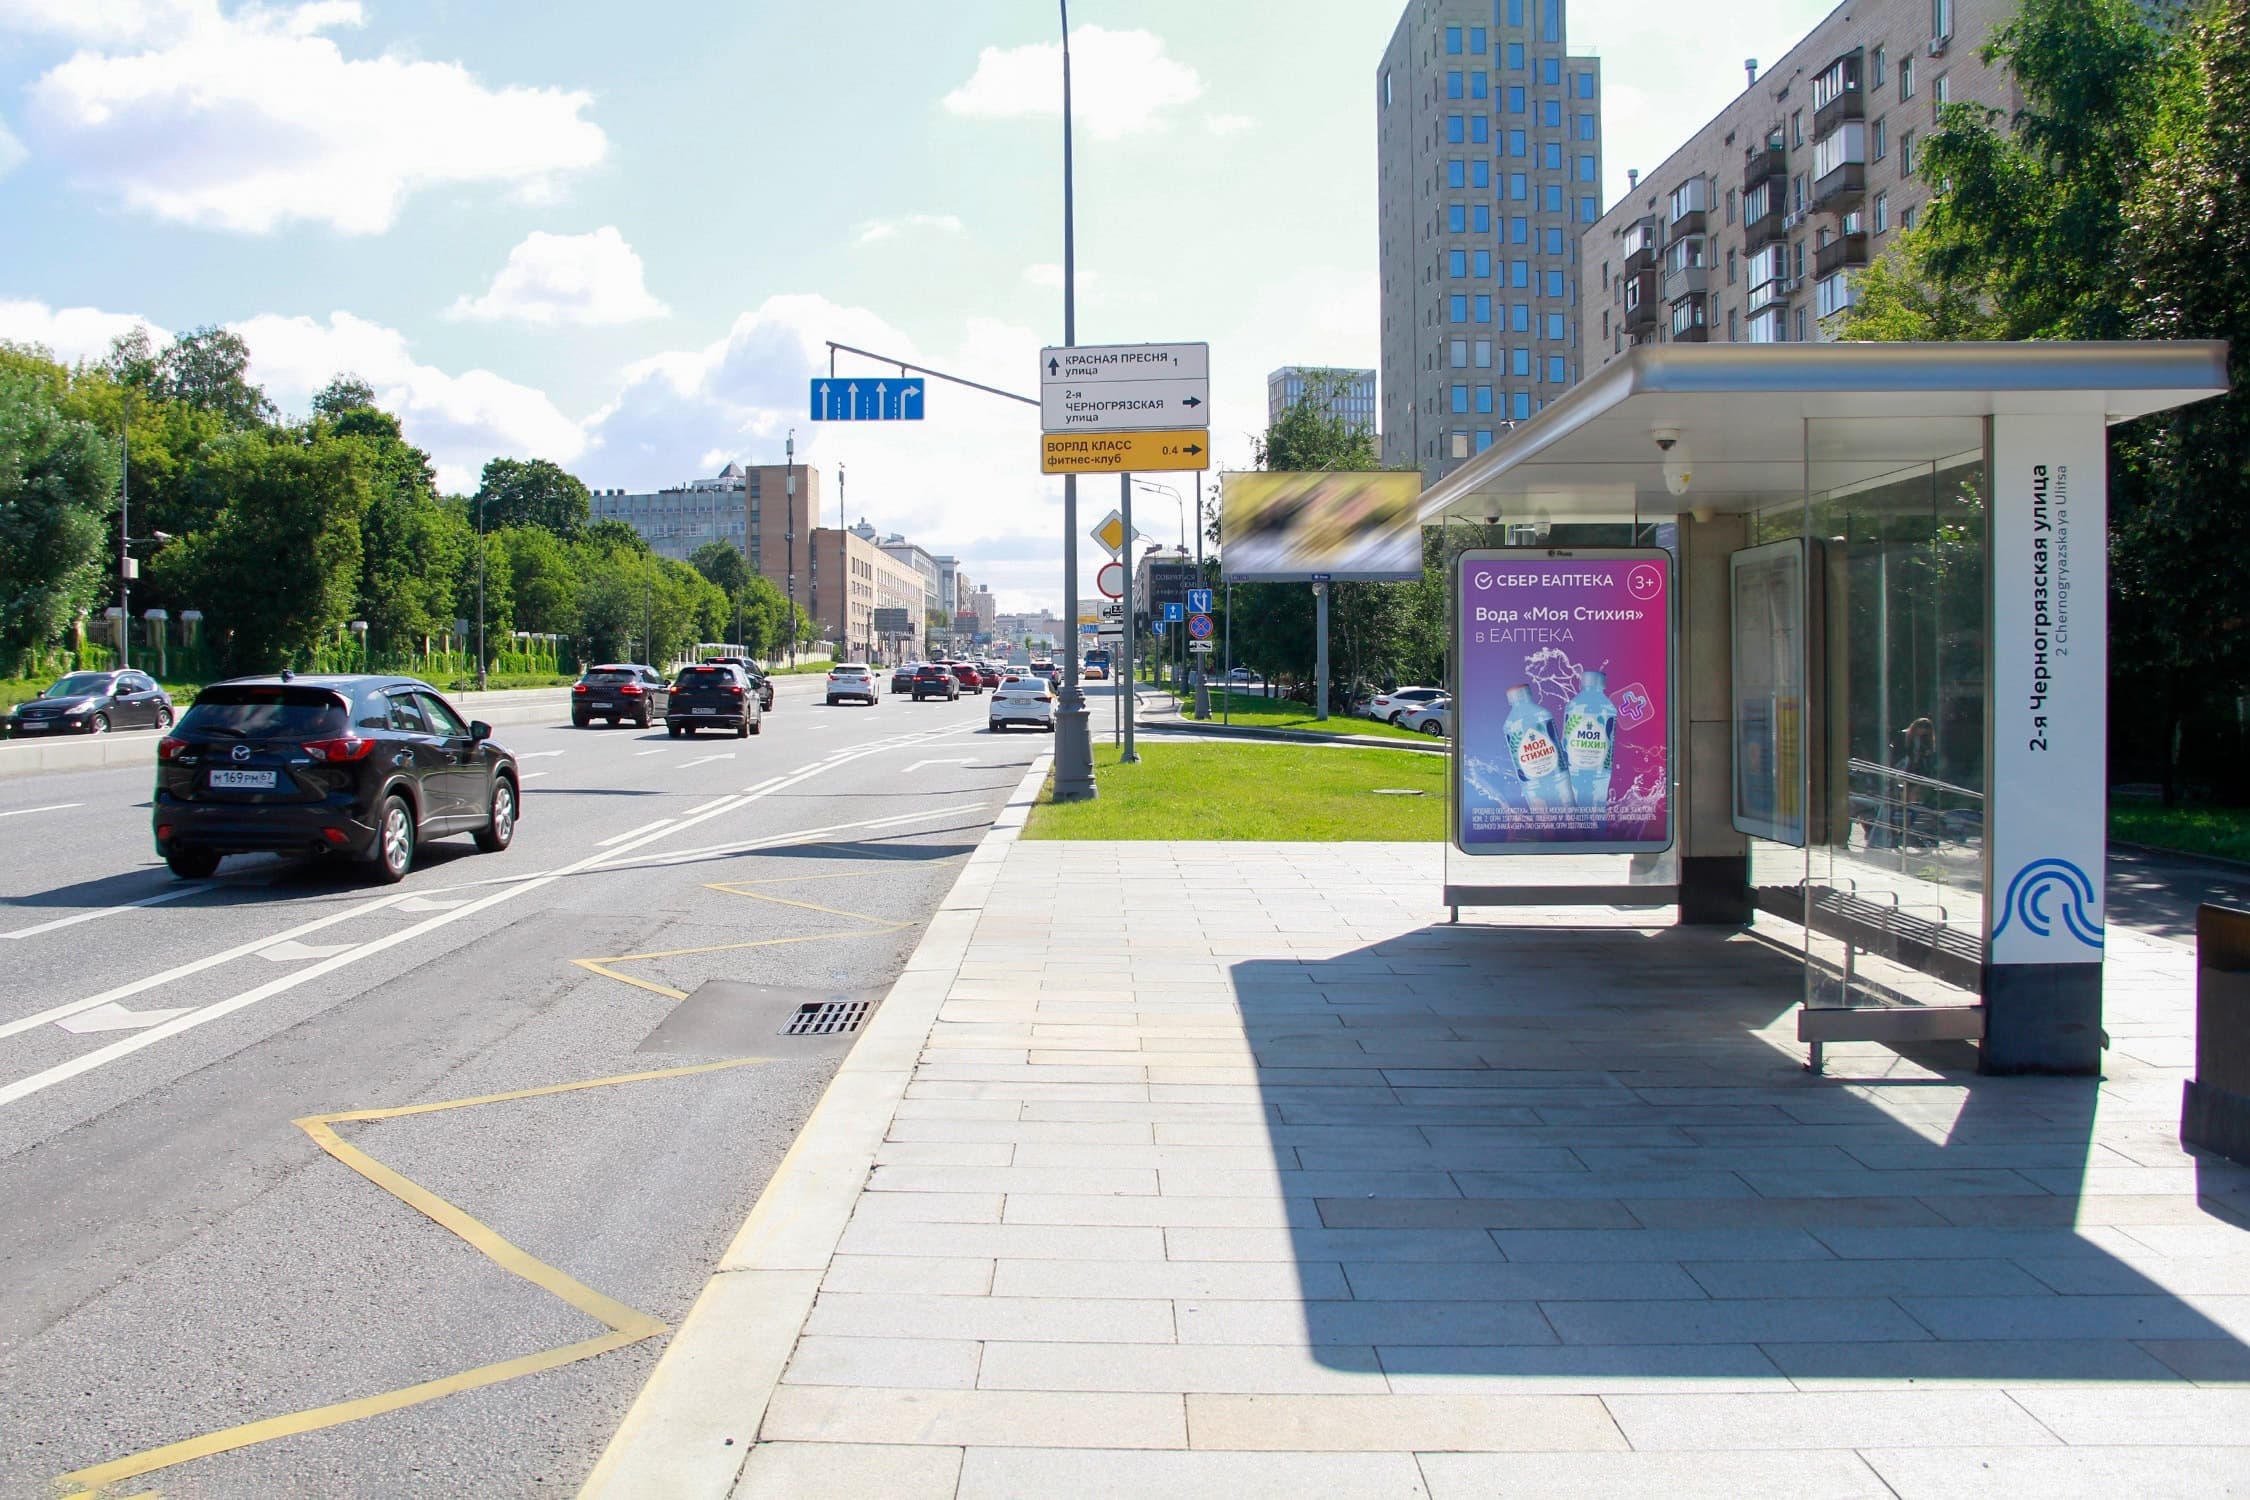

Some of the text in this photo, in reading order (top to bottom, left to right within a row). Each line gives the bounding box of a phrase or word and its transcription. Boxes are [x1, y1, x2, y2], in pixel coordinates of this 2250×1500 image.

[1065, 352, 1178, 366] КРАСНАЯ ПРЕСНЯ 1
[1065, 368, 1098, 377] улица
[1065, 390, 1082, 399] 2-я
[1065, 400, 1164, 412] ЧЕРНОГРЯЗСКАЯ
[1065, 414, 1099, 424] улица
[1047, 440, 1178, 455] ВОРЛД КЛАСС 0.4
[1047, 454, 1122, 466] фитнес-клуб
[2056, 465, 2070, 657] 2 Chernogryazskaya Ulitsa
[1496, 574, 1614, 587] СБЕР ЕАПТЕКА
[1634, 575, 1655, 590] 3+
[1475, 606, 1644, 623] Вода «Моя Стихия»
[2030, 464, 2052, 751] 2-я Черногрязская улица
[1475, 627, 1575, 643] в ЕАПТЕКА
[1577, 730, 1601, 740] МОЯ
[1523, 739, 1547, 753] МОЯ
[1570, 739, 1606, 749] СТИХИЯ
[1520, 746, 1555, 763] СТИХИЯ
